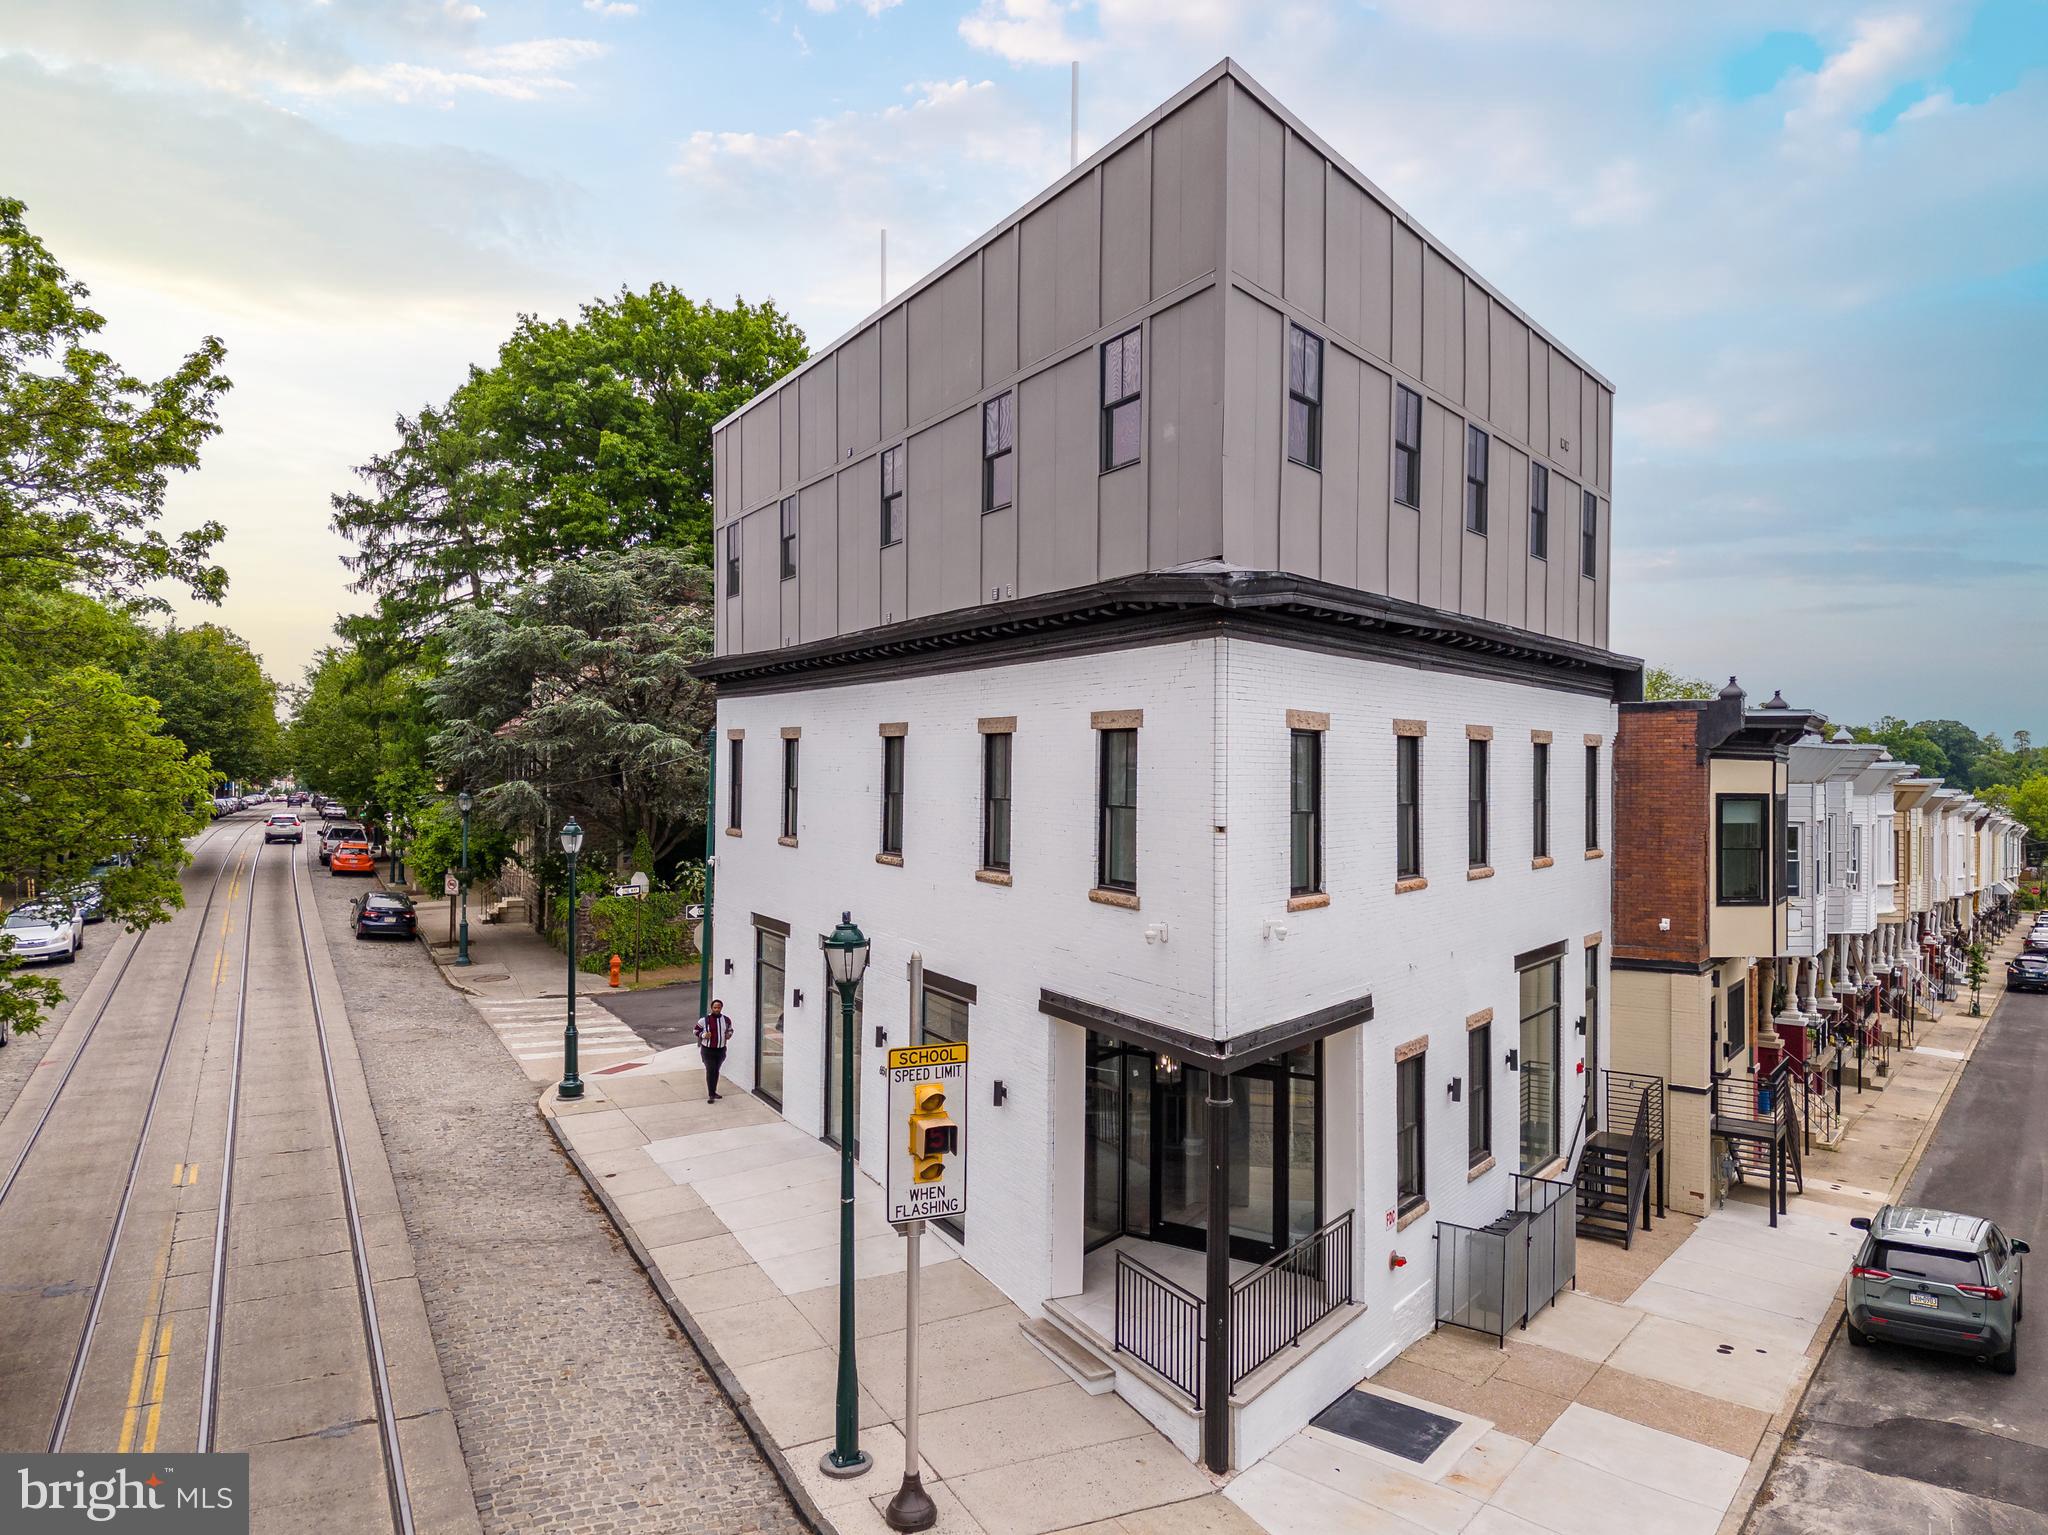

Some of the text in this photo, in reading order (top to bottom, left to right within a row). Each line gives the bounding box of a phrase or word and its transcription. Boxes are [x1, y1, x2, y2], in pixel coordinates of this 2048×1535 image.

[898, 1048, 958, 1065] SCHOOL
[894, 1064, 962, 1082] SPEED LIMIT
[910, 1186, 946, 1202] WHEN
[896, 1198, 958, 1218] FLASHING
